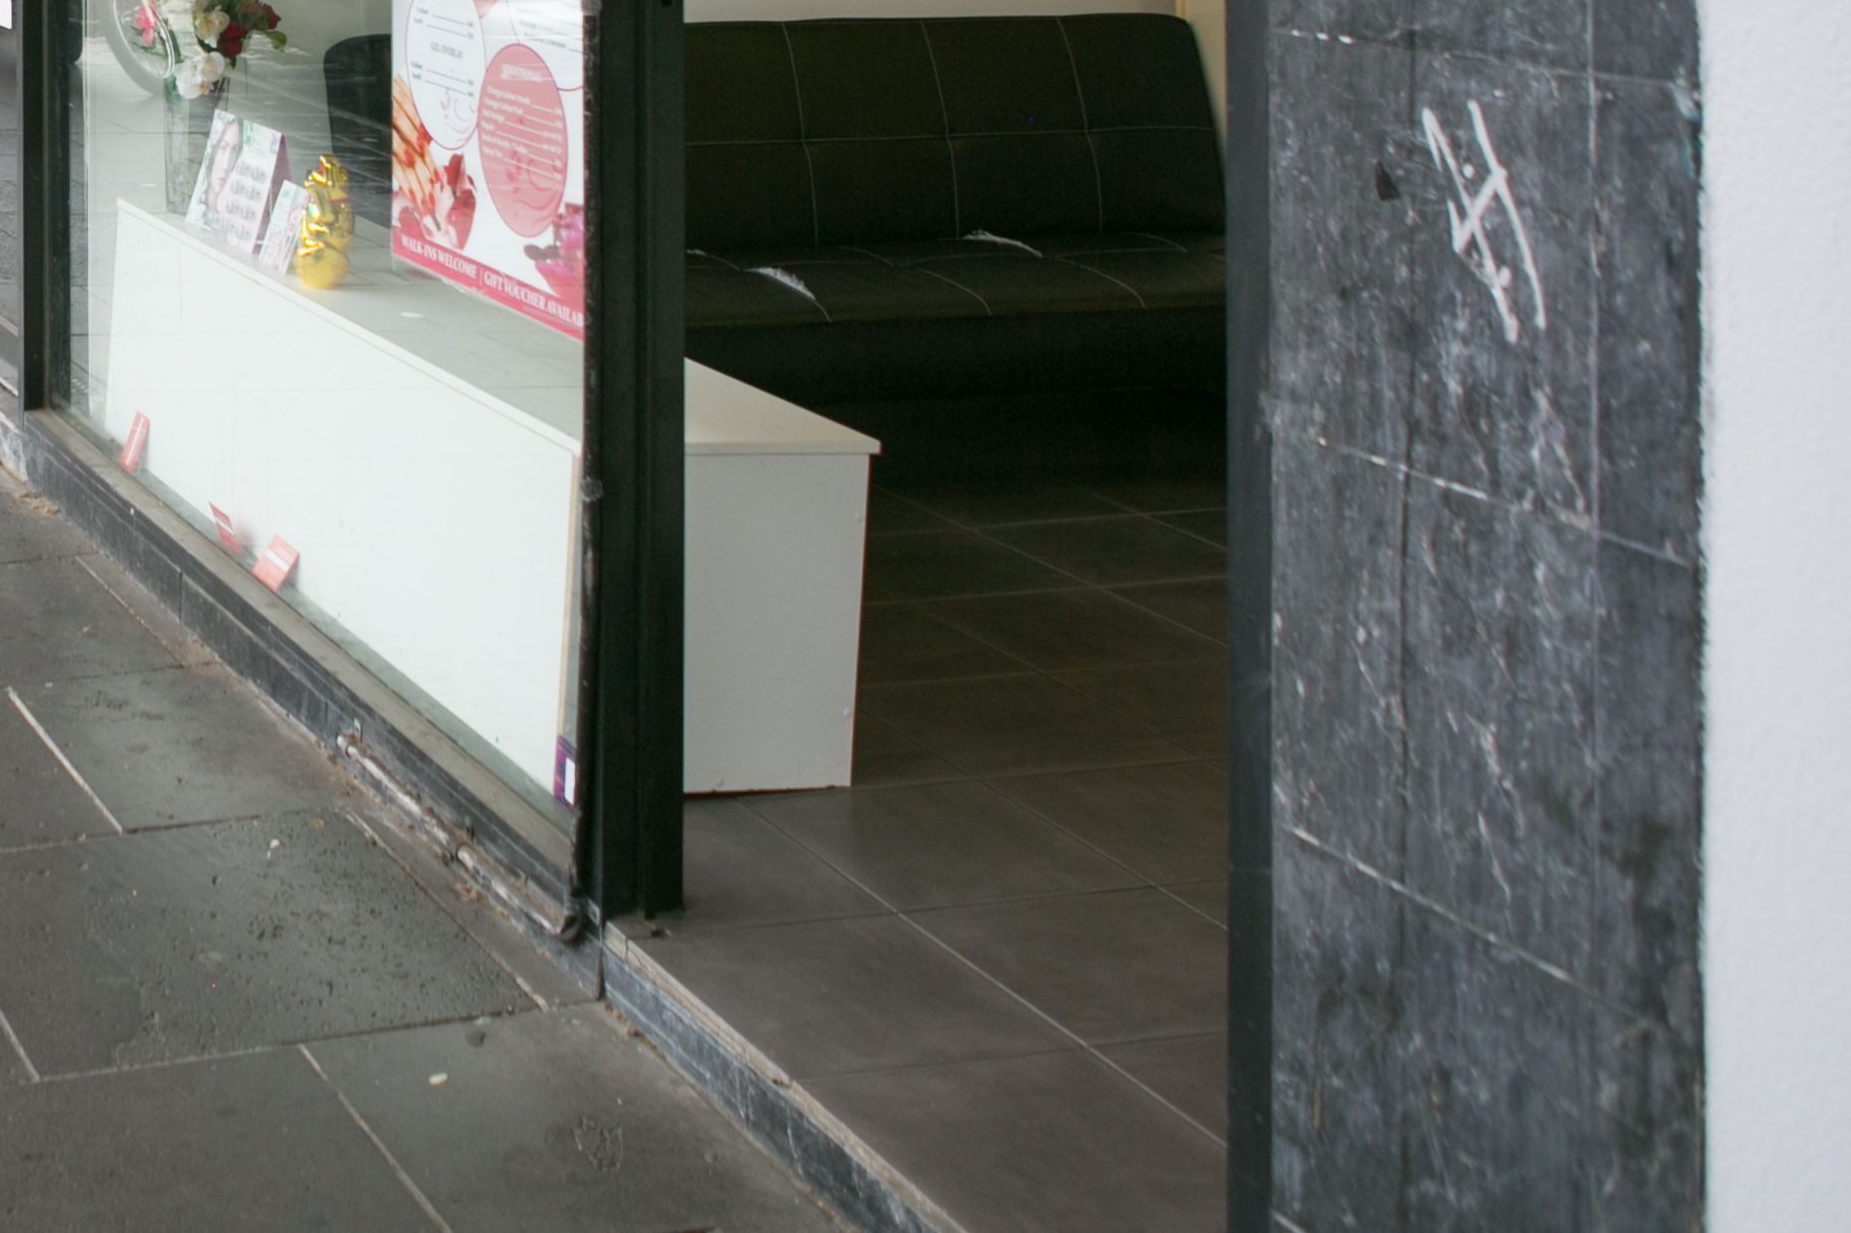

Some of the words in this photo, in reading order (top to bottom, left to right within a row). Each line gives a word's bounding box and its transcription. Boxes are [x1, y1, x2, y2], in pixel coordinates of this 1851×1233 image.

[401, 234, 437, 262] WALK-INS
[438, 248, 478, 280] WELCOME
[484, 271, 503, 292] GIFT
[503, 276, 546, 309] VOUCHER
